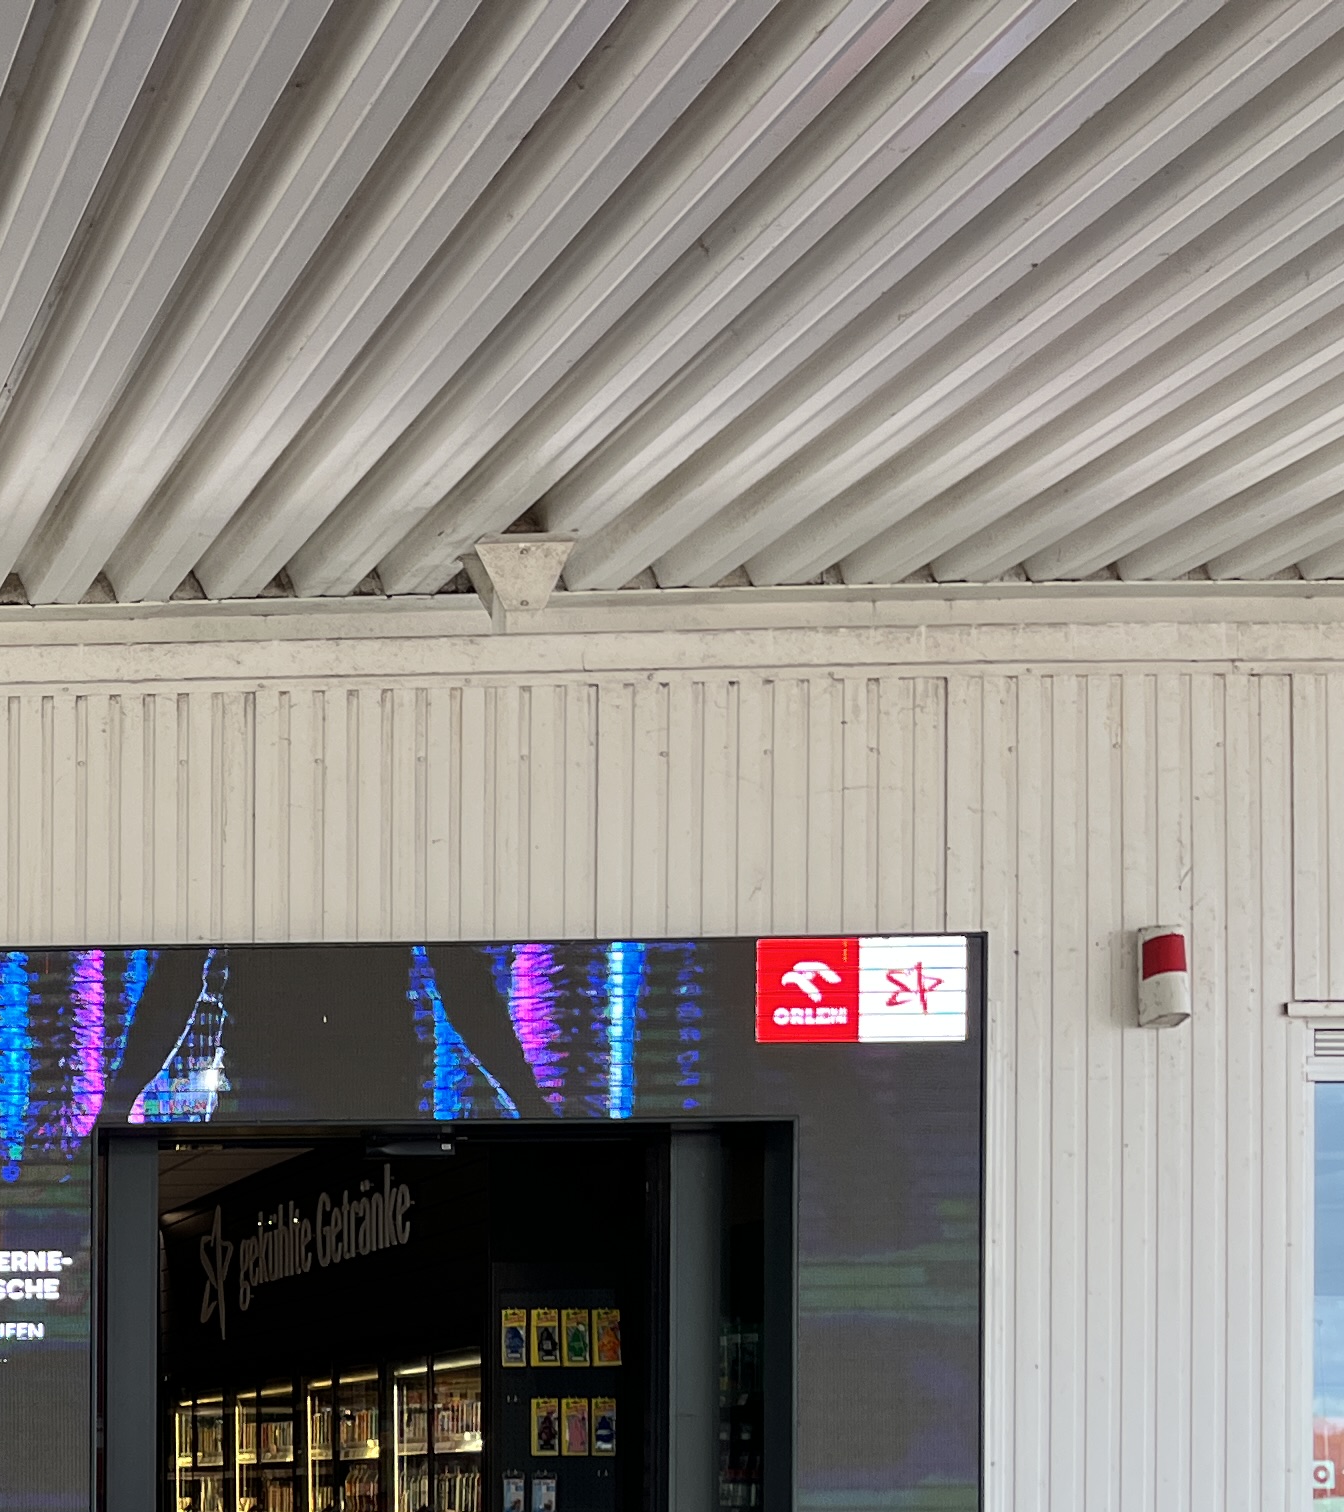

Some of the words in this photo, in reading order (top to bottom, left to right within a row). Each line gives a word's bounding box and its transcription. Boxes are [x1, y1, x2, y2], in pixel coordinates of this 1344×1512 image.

[773, 1007, 848, 1025] ORLEN
[239, 1200, 312, 1311] gekühlte
[316, 1163, 411, 1267] Getränke
